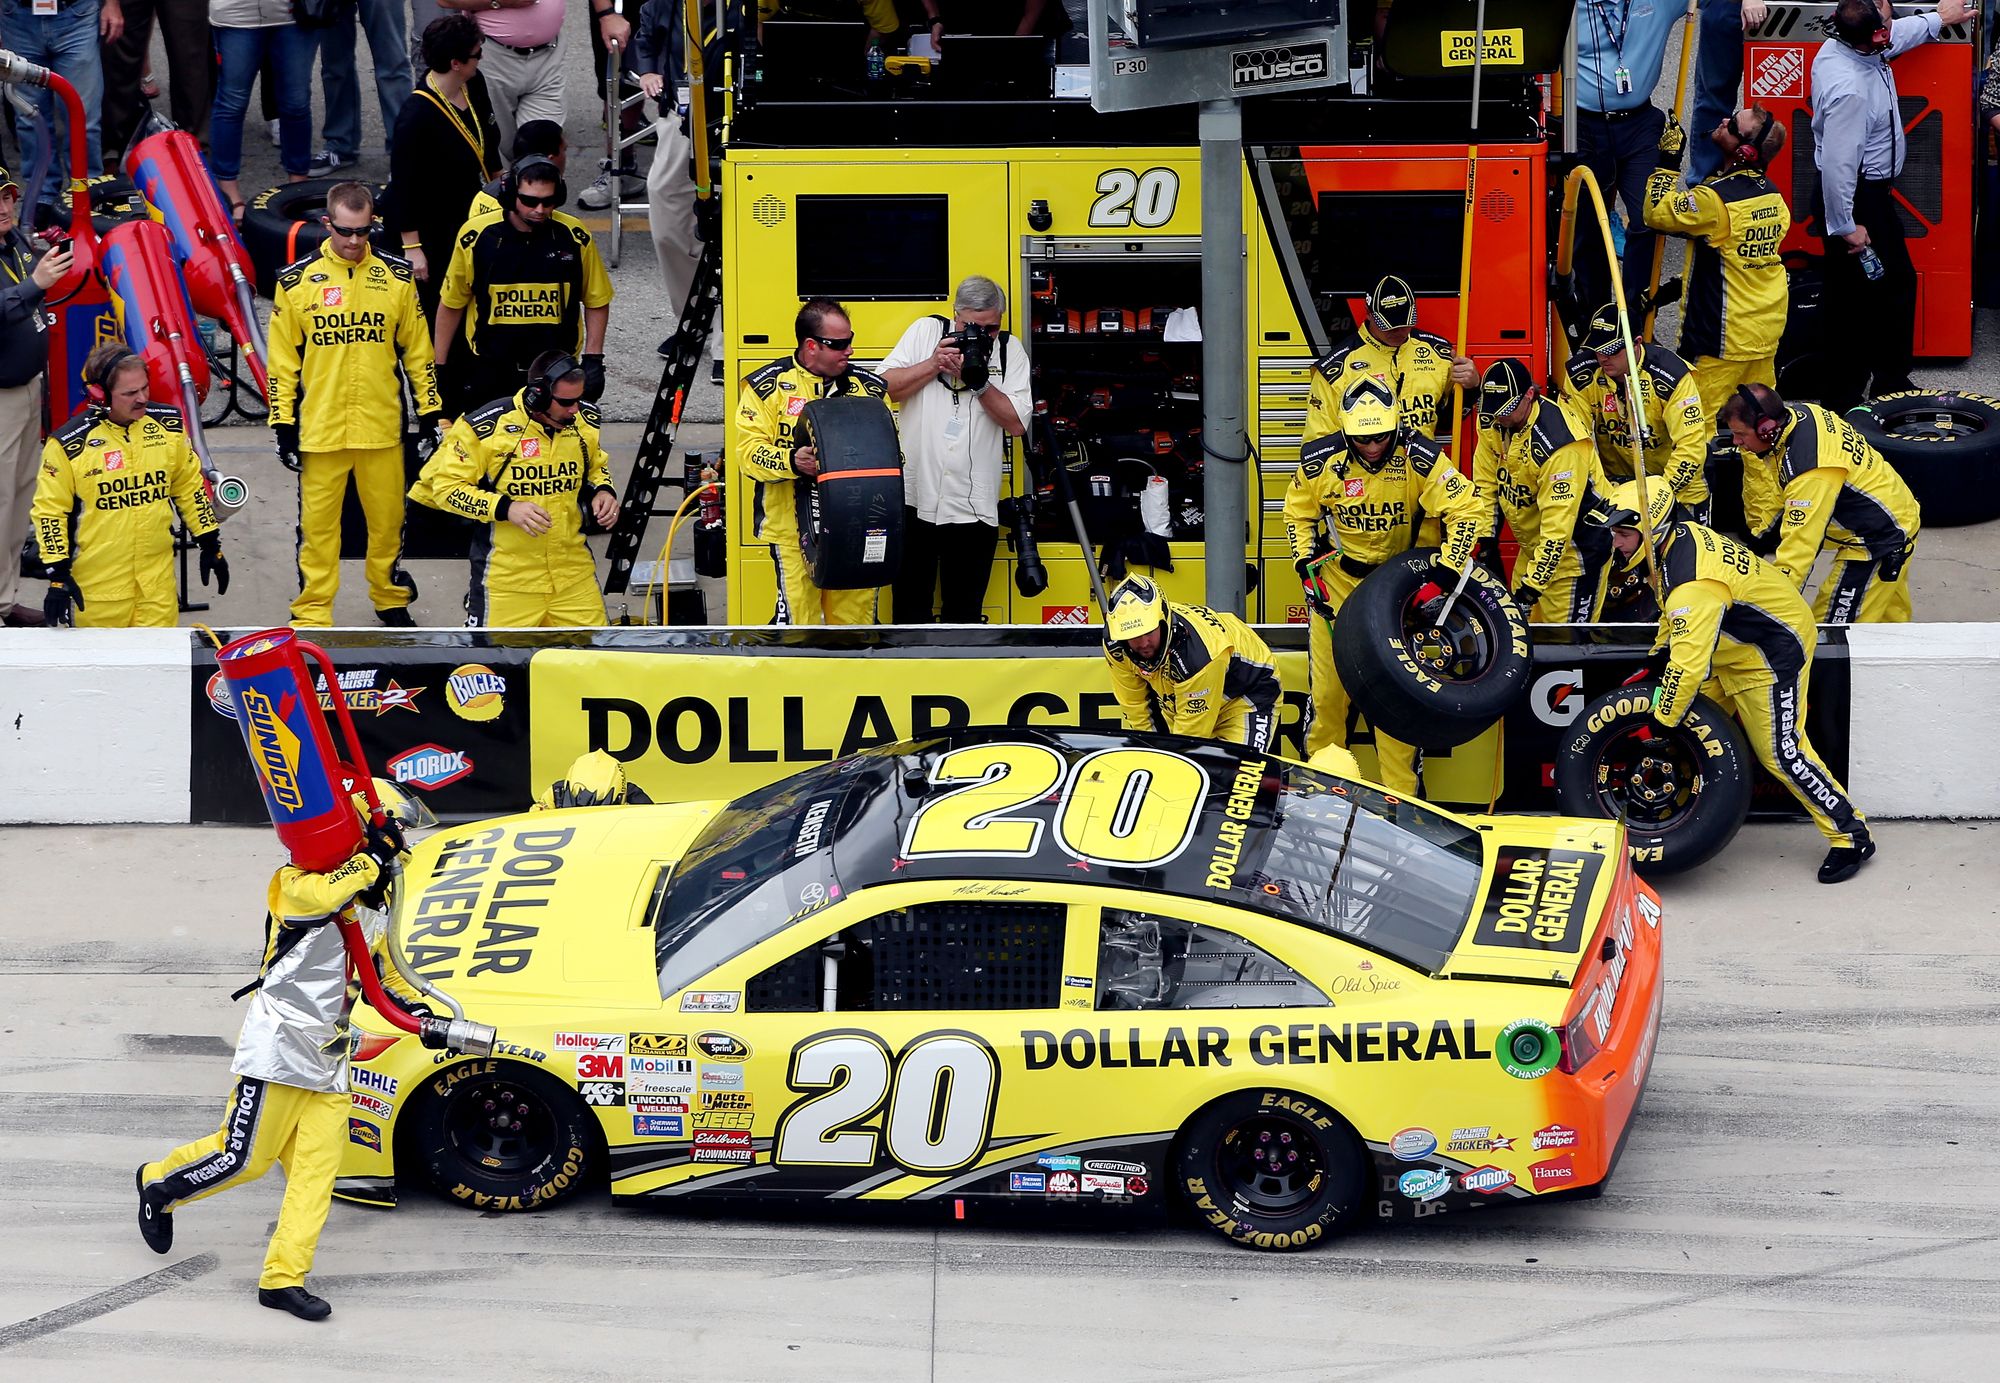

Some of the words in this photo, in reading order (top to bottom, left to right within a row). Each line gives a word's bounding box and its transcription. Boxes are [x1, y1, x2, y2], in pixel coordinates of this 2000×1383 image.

[1452, 36, 1512, 48] DOLAR
[1116, 61, 1125, 74] P
[1128, 60, 1146, 73] 30
[1752, 49, 1803, 96] HOME
[1756, 53, 1778, 72] THE
[1772, 66, 1803, 96] DEPOT
[1088, 166, 1179, 228] 20
[1737, 242, 1776, 258] GENER
[366, 277, 388, 285] TOYOTA
[495, 290, 560, 304] DOLLAR
[313, 312, 385, 329] DOLLAR
[312, 327, 386, 346] GENERAL
[426, 362, 438, 406] DOLLAR
[269, 377, 281, 421] DOLLAR
[1399, 394, 1434, 413] LAR
[1402, 413, 1436, 429] ERAL
[1684, 418, 1705, 427] TOYOTA
[1886, 433, 1957, 442] EAGLE
[511, 461, 578, 481] DOLLAR
[752, 454, 788, 471] GENERAL
[98, 471, 167, 495] DOLLAR
[1671, 461, 1691, 491] LLAR
[1676, 464, 1700, 495] NERAL
[506, 478, 578, 496] GENERAL
[1447, 484, 1467, 500] TOYOTA
[96, 486, 170, 510] GENERAL
[447, 496, 489, 517] GENERAL
[452, 488, 489, 509] DOLLAR
[1550, 494, 1575, 502] TOYOTA
[1649, 488, 1665, 514] DOLLAR
[1652, 490, 1671, 519] GENERAL
[1334, 502, 1405, 516] DOLLAR
[1338, 514, 1409, 532] GENERAL
[41, 518, 56, 554] GENER
[1446, 521, 1468, 562] DOLLAR
[1455, 519, 1478, 569] GENERAL
[1532, 540, 1556, 582] DOLLAR
[1539, 540, 1567, 585] GENERAL
[1832, 587, 1857, 623] ERAL
[1120, 618, 1143, 628] DOLLAR
[1120, 622, 1145, 632] GENERAL
[1671, 629, 1690, 638] TOYOTA
[338, 672, 345, 681] &
[344, 670, 377, 681] ENERGY
[1388, 637, 1443, 694] EAGLE
[317, 679, 375, 691] SPIALISTS
[448, 674, 506, 706] BUGLES
[1661, 669, 1683, 716] GENERAL
[380, 689, 410, 705] 2
[1530, 668, 1585, 727] G
[1185, 705, 1209, 714] TOYOTA
[1253, 714, 1269, 752] ERAL
[1587, 696, 1726, 759] GOODEAR
[1780, 686, 1797, 760] GENERAL
[246, 695, 298, 806] SUNOCO
[395, 750, 466, 784] CLOROX
[1225, 760, 1267, 821] GENERAL
[1791, 757, 1840, 810] DOLLAR
[900, 743, 1211, 868] 20
[794, 799, 833, 858] KENSETH
[1205, 820, 1248, 891] DOLLAR
[406, 827, 506, 980] GENERAL
[466, 827, 577, 978] DOLLAR
[1494, 858, 1546, 934] DOLLAR
[1530, 858, 1585, 942] GENERAL
[1637, 892, 1662, 929] 20
[1331, 975, 1361, 995] Old
[1363, 973, 1401, 996] Spice
[1502, 1017, 1554, 1037] AMERICAN
[556, 1034, 598, 1050] Holley
[596, 1036, 624, 1050] EFI
[631, 1046, 666, 1055] MECHANIX
[665, 1048, 686, 1056] WEAR
[710, 1044, 732, 1053] Sprint
[1020, 1026, 1233, 1070] DOLLAR
[1248, 1019, 1492, 1067] GENERAL
[578, 1054, 623, 1078] 3M
[631, 1058, 673, 1072] Mobil
[1505, 1063, 1552, 1079] ETHANOL
[432, 1061, 498, 1097] EAGLE
[644, 1083, 692, 1093] freescale
[630, 1096, 678, 1104] LINCOLN
[713, 1100, 752, 1109] Meter
[715, 1093, 746, 1101] Auto
[771, 1028, 1002, 1177] 20
[231, 1085, 257, 1153] DOLLAR
[641, 1105, 684, 1113] WELDERS
[1260, 1092, 1333, 1130] EAGLE
[692, 1112, 755, 1129] JEGS
[352, 1128, 380, 1144] SUNOCO
[694, 1132, 750, 1145] Edelbrock
[1538, 1129, 1575, 1138] Hamburger
[1543, 1136, 1575, 1146] Helper
[693, 1149, 752, 1161] FLOWMASTER
[1447, 1139, 1491, 1151] STACKER
[1492, 1138, 1510, 1148] 2
[183, 1152, 237, 1186] GENERAL
[1037, 1157, 1080, 1166] DOOSAN
[1089, 1162, 1141, 1172] FREIGHTLINER
[1401, 1169, 1446, 1195] Sparkle
[1465, 1170, 1512, 1191] CLOROX
[1534, 1167, 1572, 1178] Hanes
